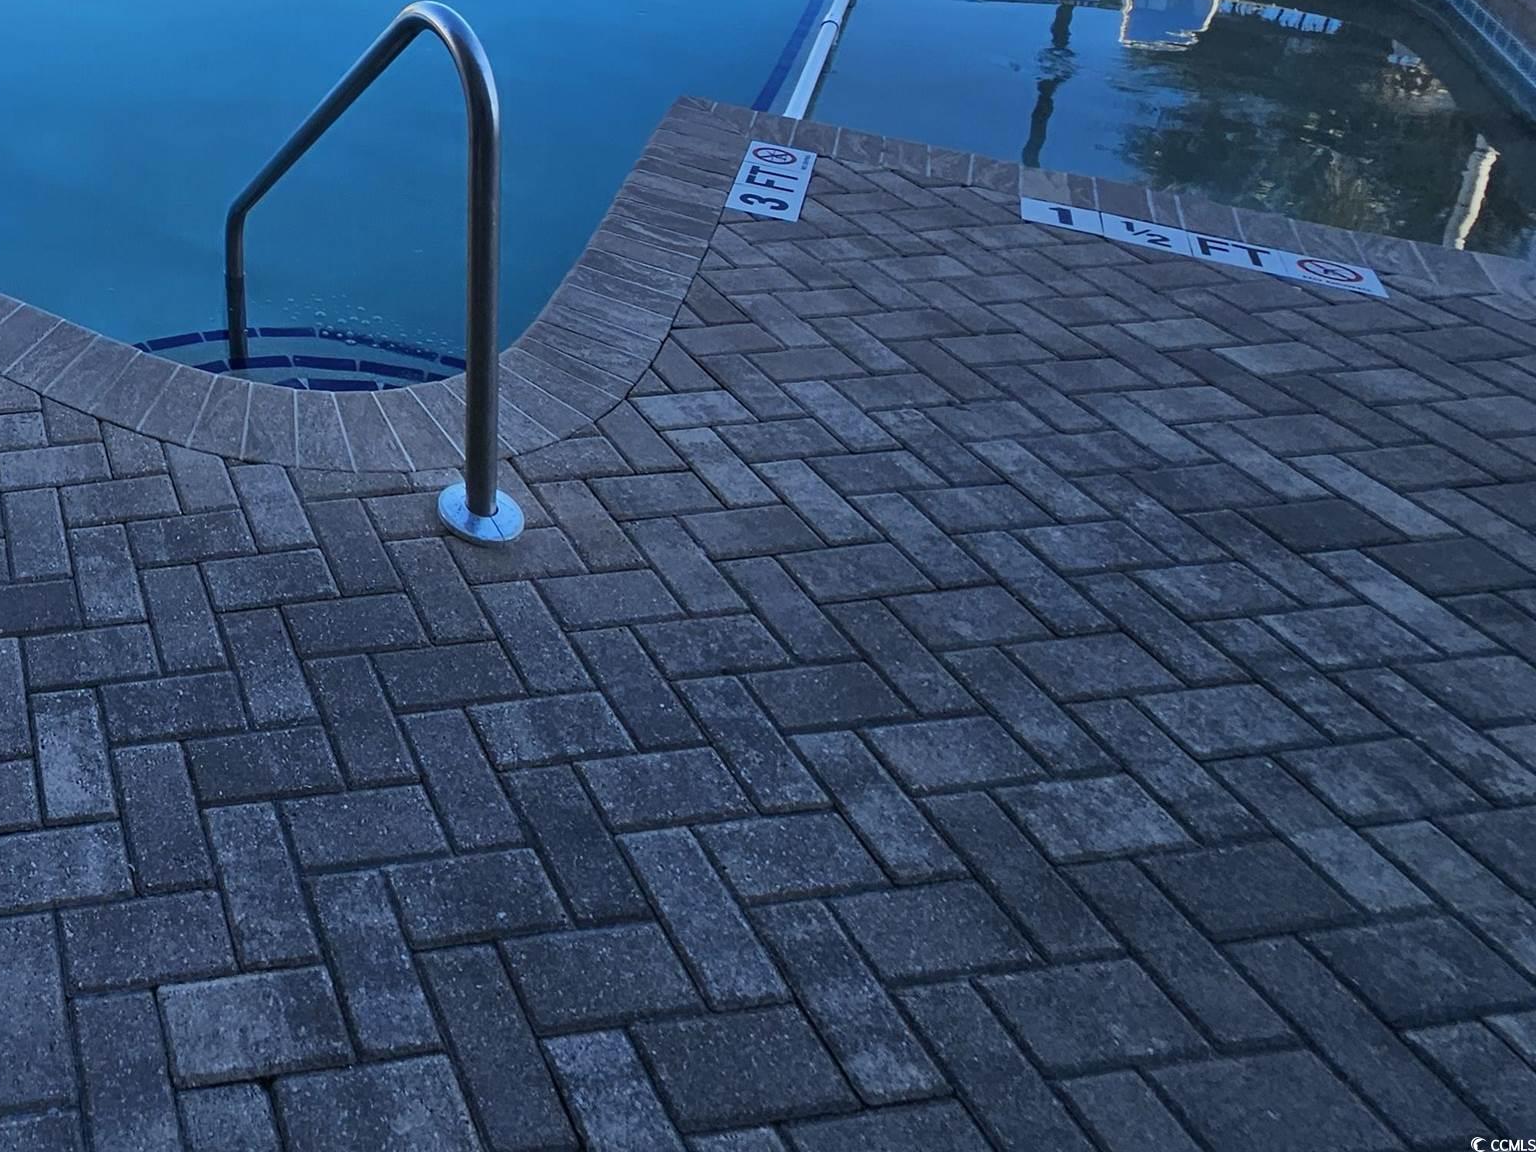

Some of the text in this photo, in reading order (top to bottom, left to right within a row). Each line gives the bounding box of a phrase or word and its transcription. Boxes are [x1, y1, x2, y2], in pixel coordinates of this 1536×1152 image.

[739, 165, 799, 211] 3 FT
[1049, 206, 1074, 226] 1
[1196, 236, 1271, 268] FT
